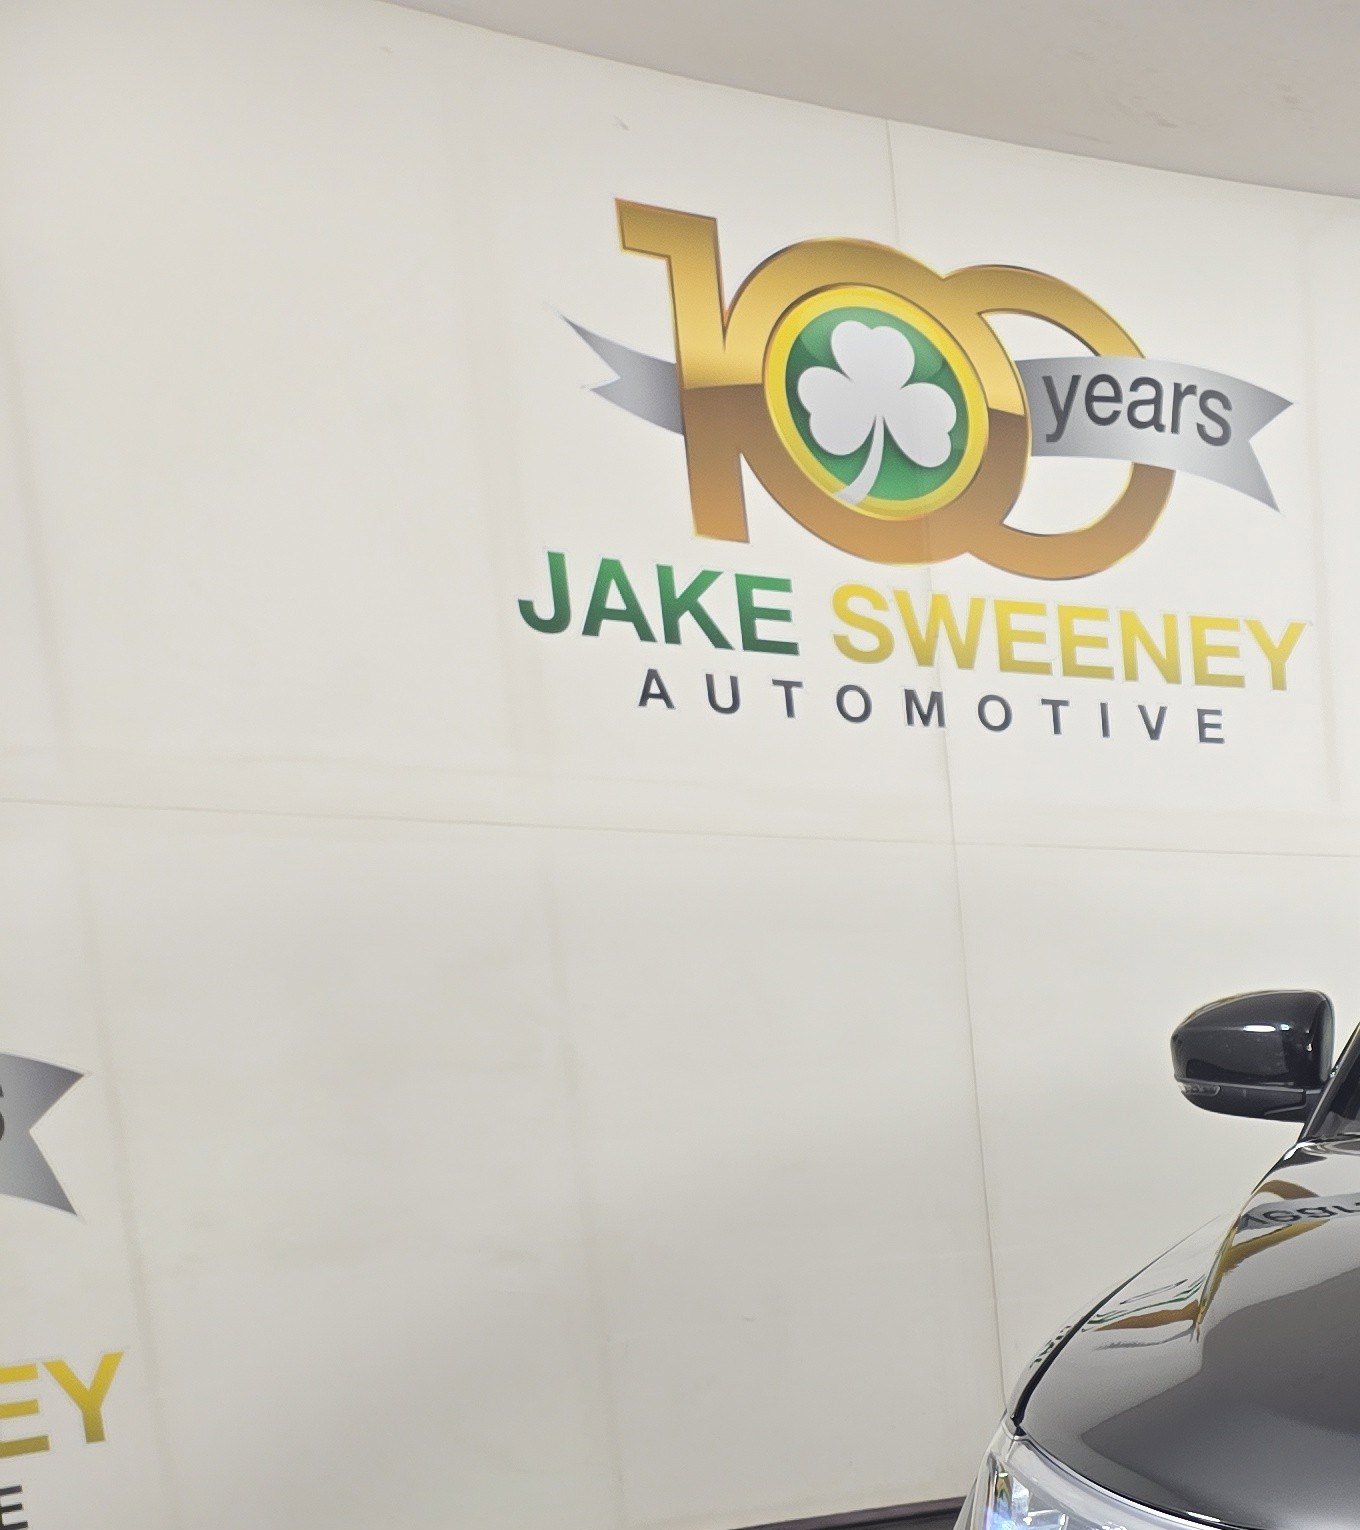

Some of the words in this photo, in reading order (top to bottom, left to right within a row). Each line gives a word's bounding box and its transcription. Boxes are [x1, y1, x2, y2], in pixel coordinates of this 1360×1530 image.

[615, 198, 1176, 581] 100
[1042, 371, 1234, 447] years
[518, 550, 800, 657] JAKE
[831, 584, 1307, 692] SWEENEY
[637, 668, 1226, 745] AUTOMOTIVE
